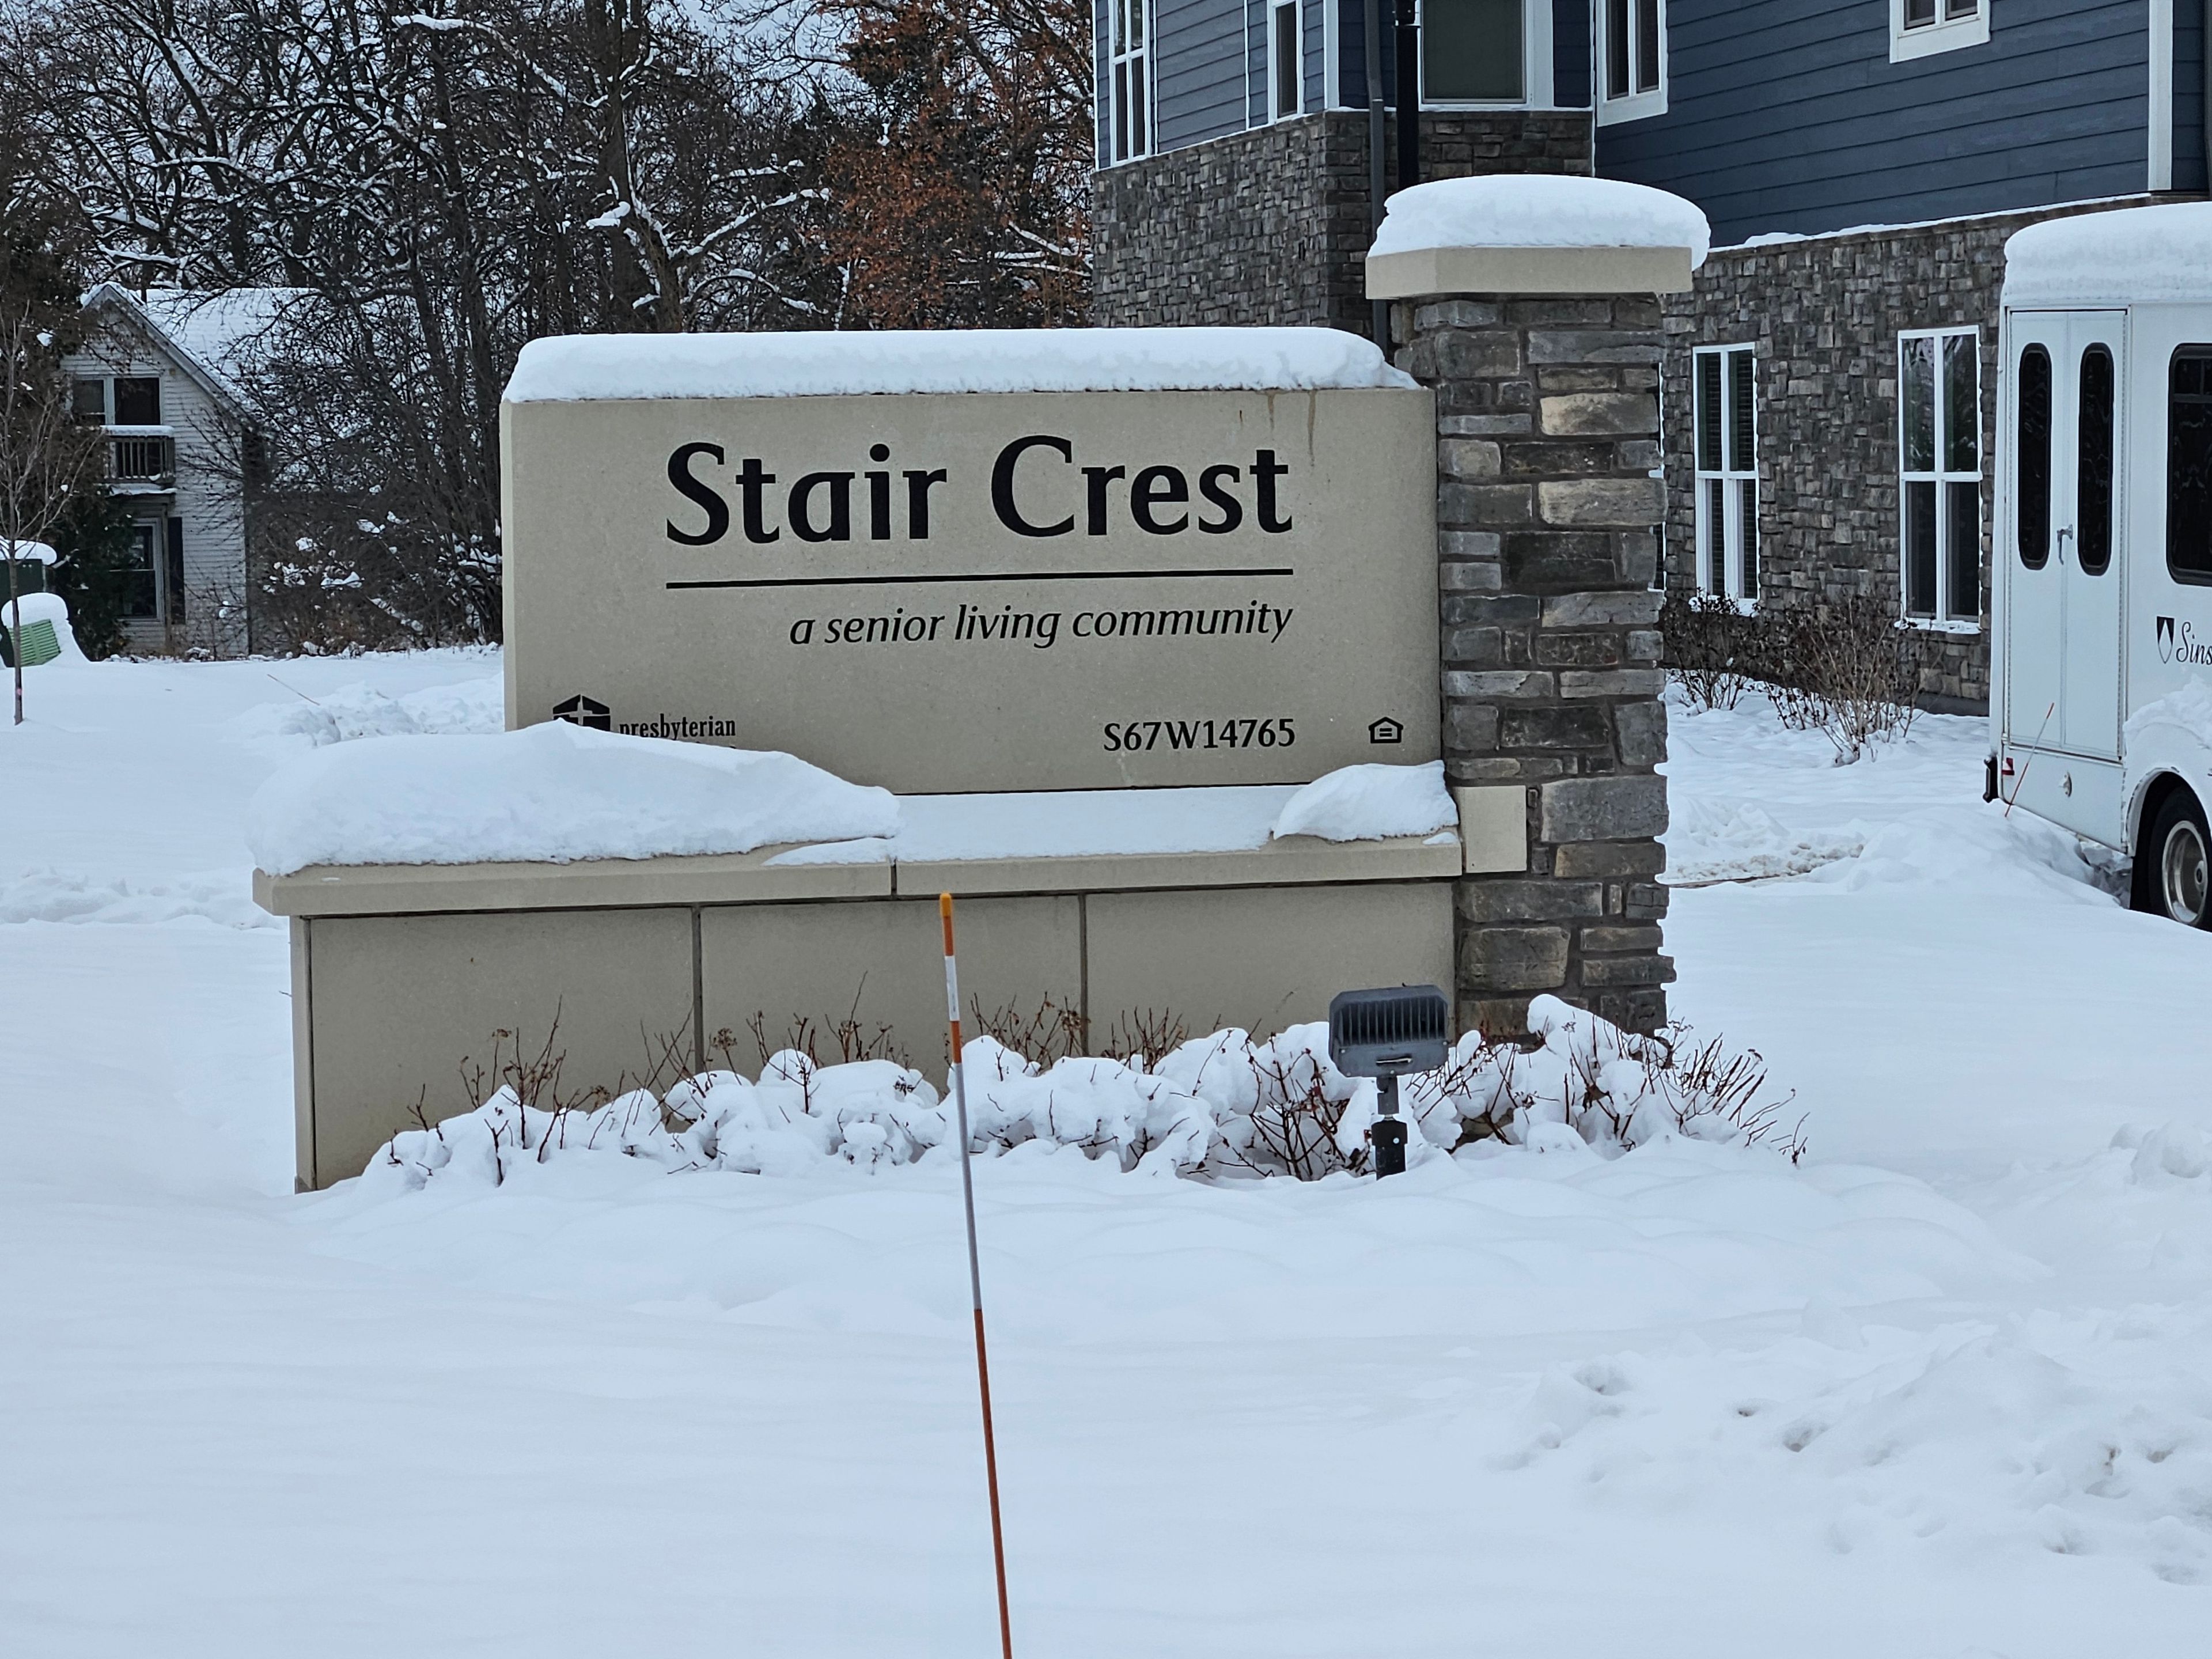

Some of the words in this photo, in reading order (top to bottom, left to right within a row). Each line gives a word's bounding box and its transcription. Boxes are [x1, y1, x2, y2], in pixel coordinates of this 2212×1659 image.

[666, 441, 948, 547] Stair
[990, 434, 1293, 538] Crest
[789, 619, 816, 645] a
[823, 607, 946, 645] senior
[954, 603, 1062, 649] living
[1072, 599, 1294, 644] community
[1103, 718, 1296, 752] S67W14765
